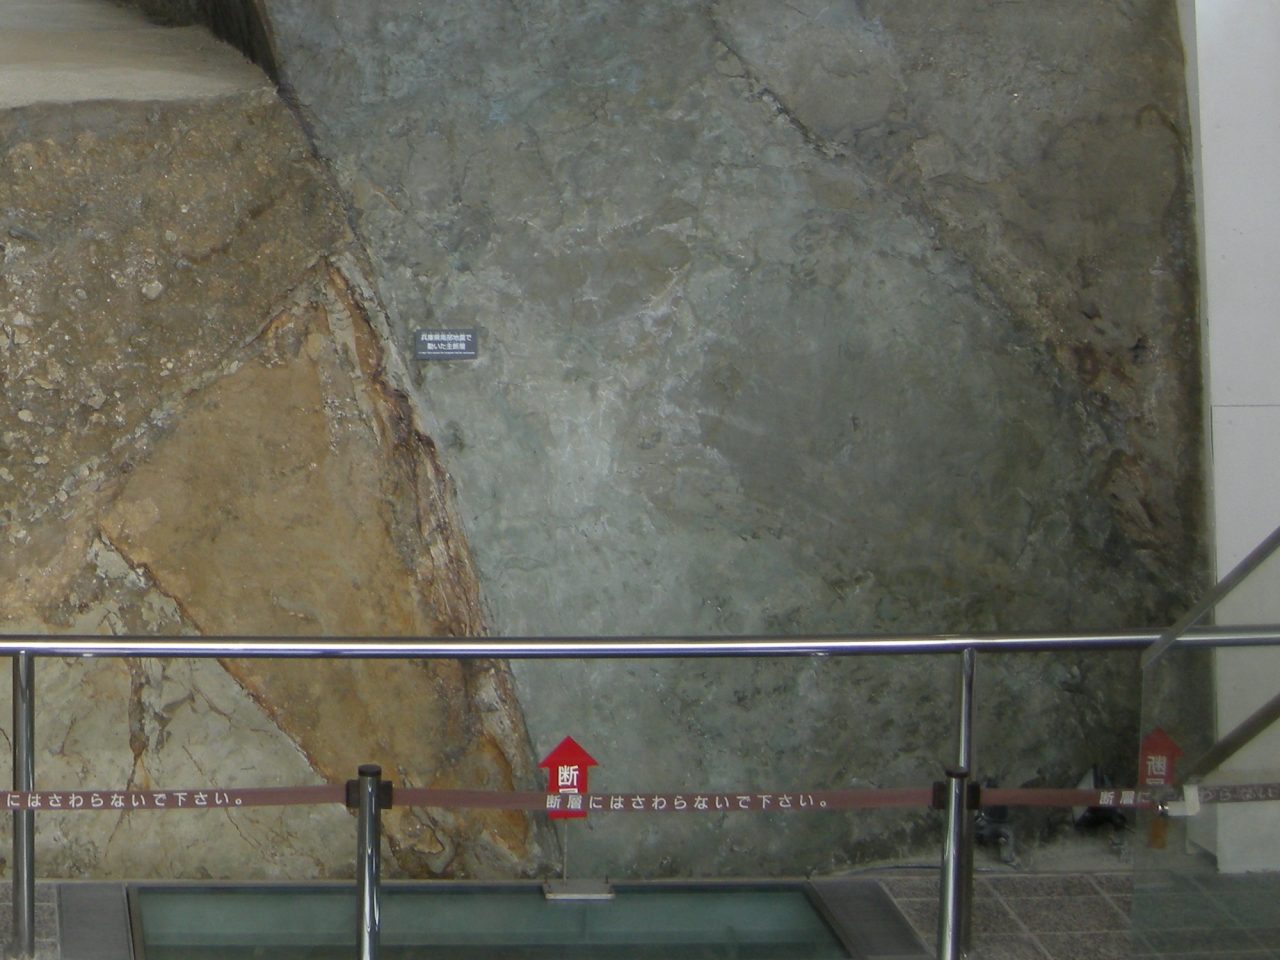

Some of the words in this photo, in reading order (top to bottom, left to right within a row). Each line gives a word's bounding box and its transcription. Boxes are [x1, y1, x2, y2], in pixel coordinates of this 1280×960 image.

[558, 765, 579, 793] 断
[546, 794, 827, 810] 断層にはさわらないで下さい。
